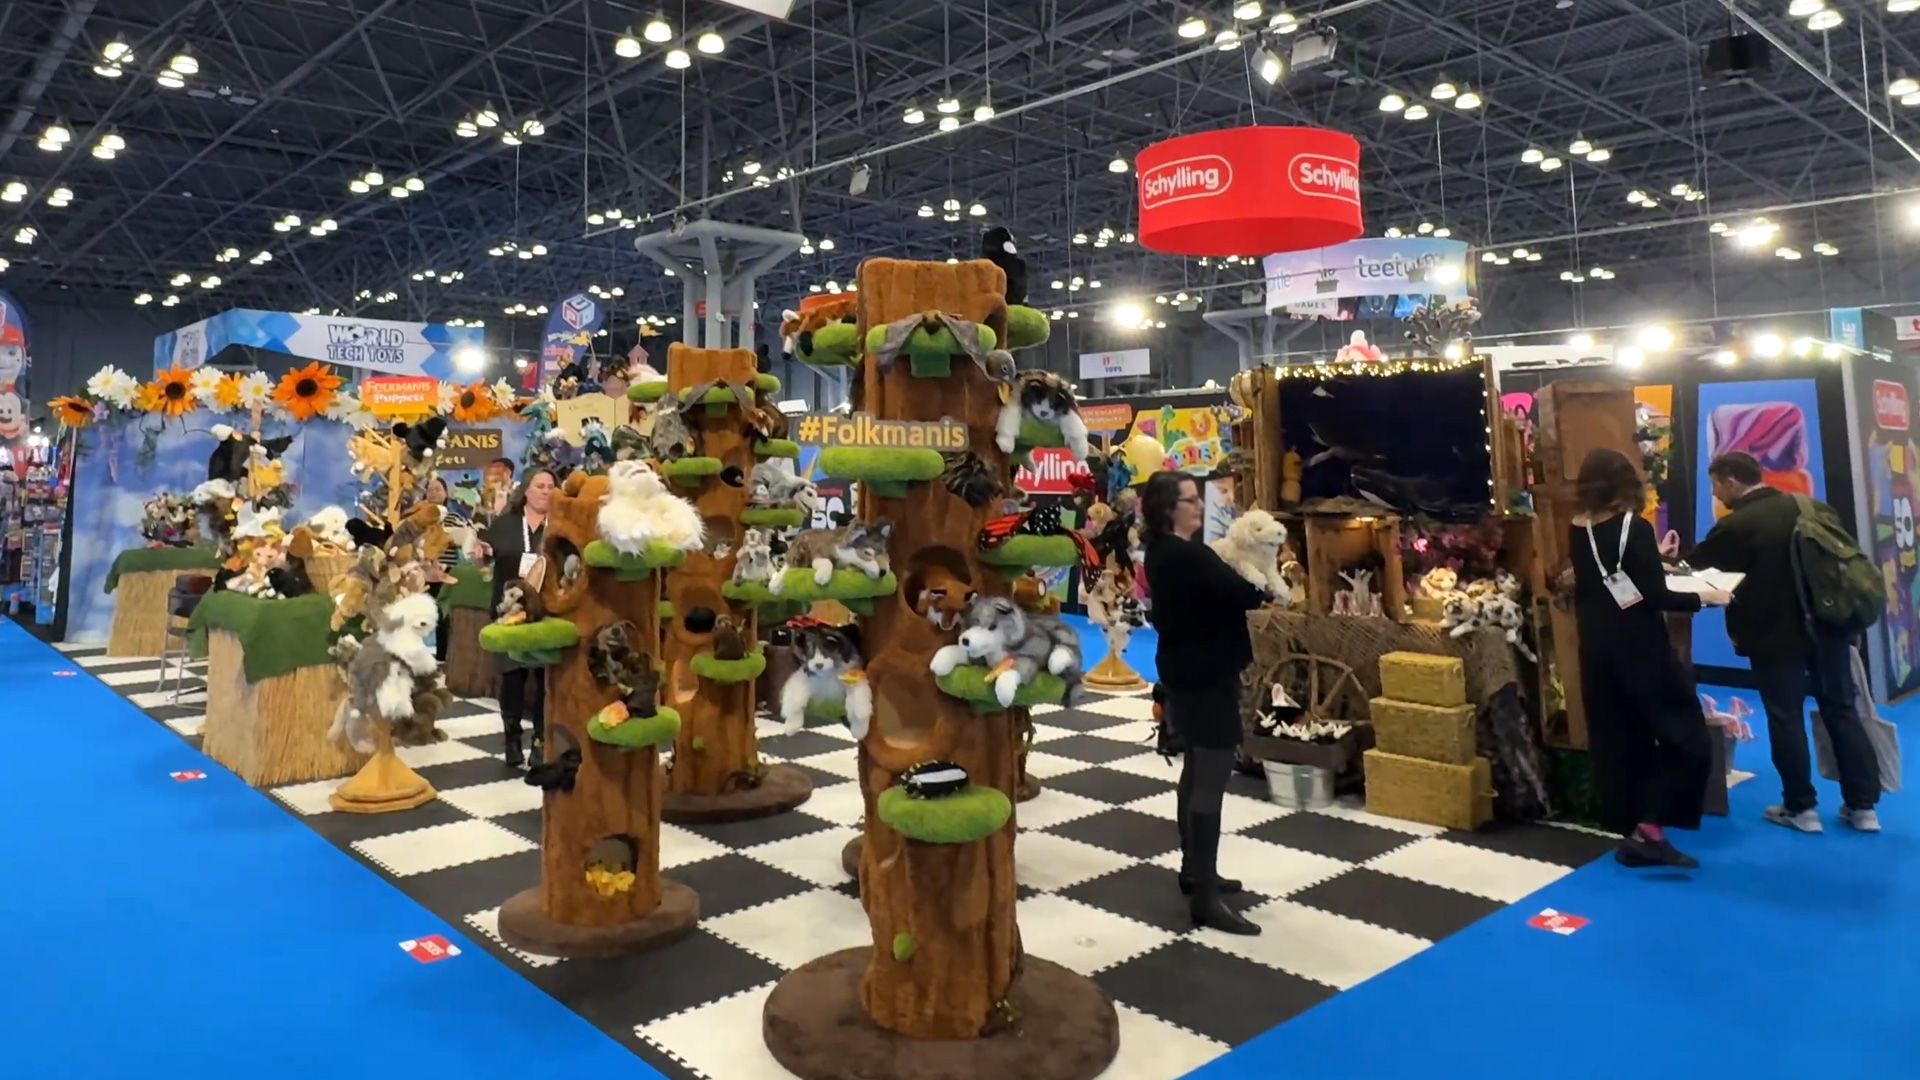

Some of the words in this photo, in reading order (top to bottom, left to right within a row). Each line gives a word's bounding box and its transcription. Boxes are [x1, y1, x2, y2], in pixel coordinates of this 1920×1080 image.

[1145, 166, 1219, 199] Schylling
[327, 324, 405, 348] WORLD
[326, 344, 365, 362] TECH
[367, 348, 404, 363] TOYS
[798, 415, 966, 448] #Folkmanis
